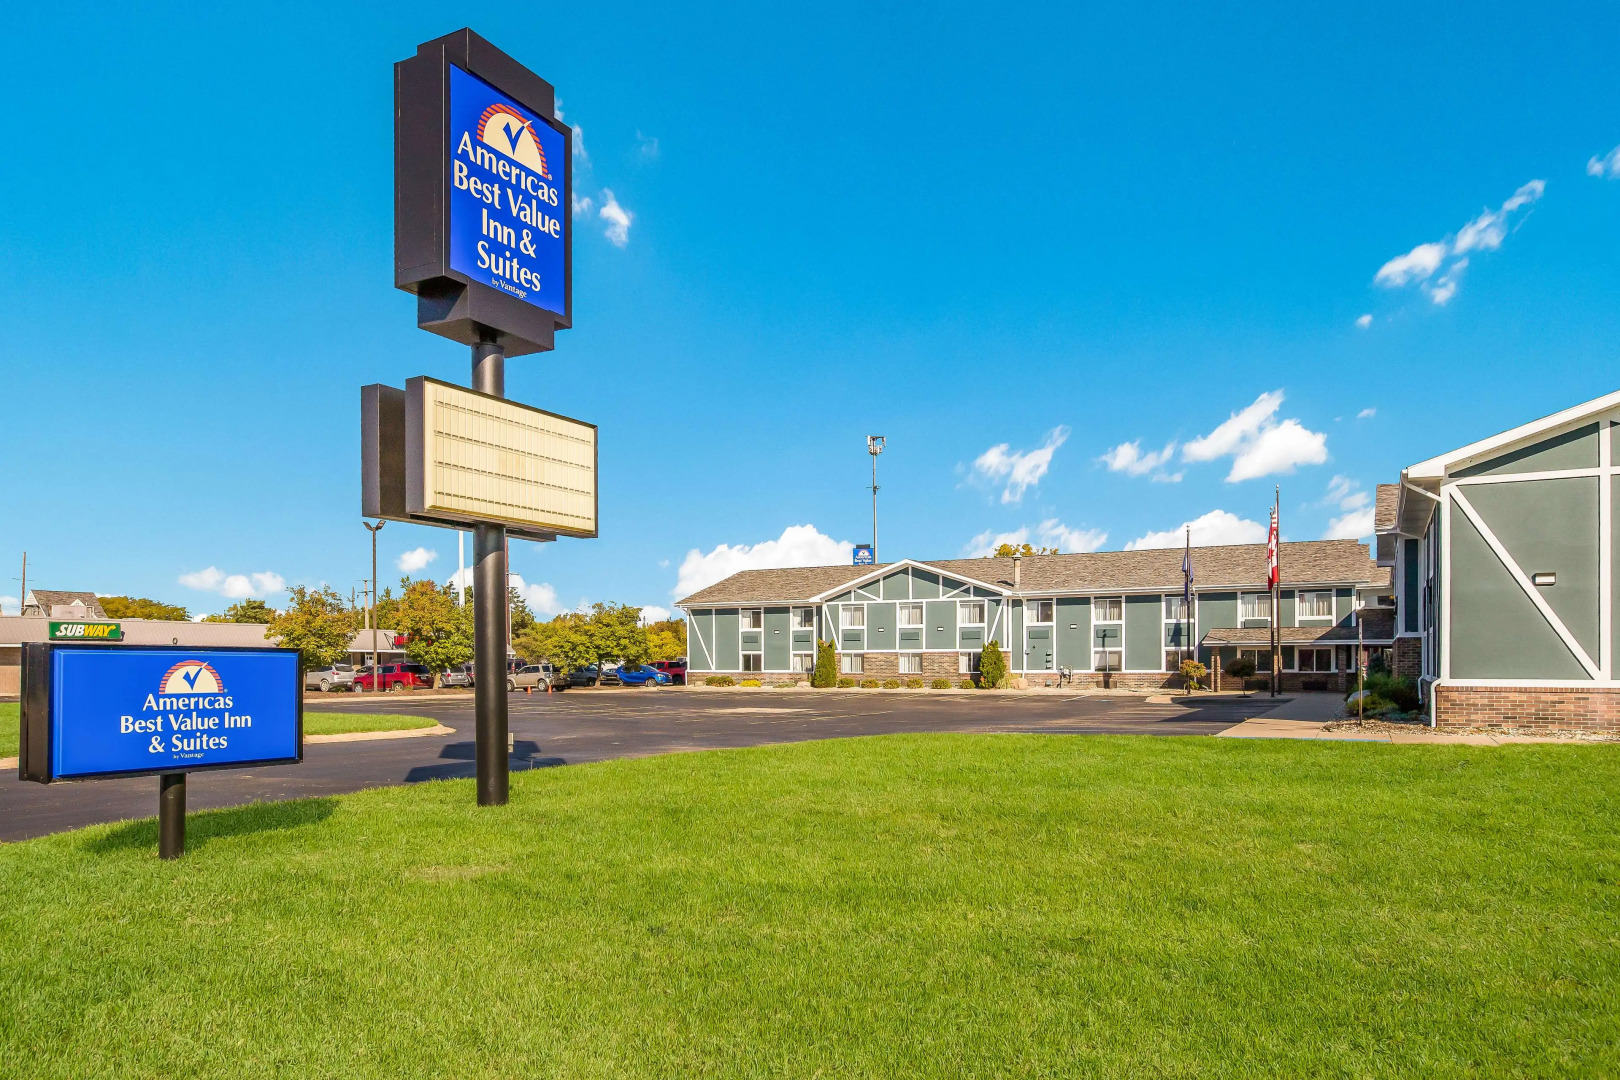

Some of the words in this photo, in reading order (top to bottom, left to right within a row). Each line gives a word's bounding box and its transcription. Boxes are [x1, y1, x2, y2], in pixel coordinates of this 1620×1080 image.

[457, 131, 558, 207] Americas
[453, 159, 501, 210] Best
[507, 188, 561, 239] Value
[482, 208, 516, 249] Inn
[520, 229, 537, 258] &
[477, 240, 541, 292] Suites
[491, 276, 499, 288] by
[500, 279, 527, 299] Vantage
[55, 624, 117, 637] SUBWAY
[142, 693, 233, 711] Americas
[120, 715, 163, 734] Best
[168, 713, 219, 731] Value
[224, 712, 252, 729] Inn
[148, 735, 165, 753] &
[171, 733, 228, 752] Suites
